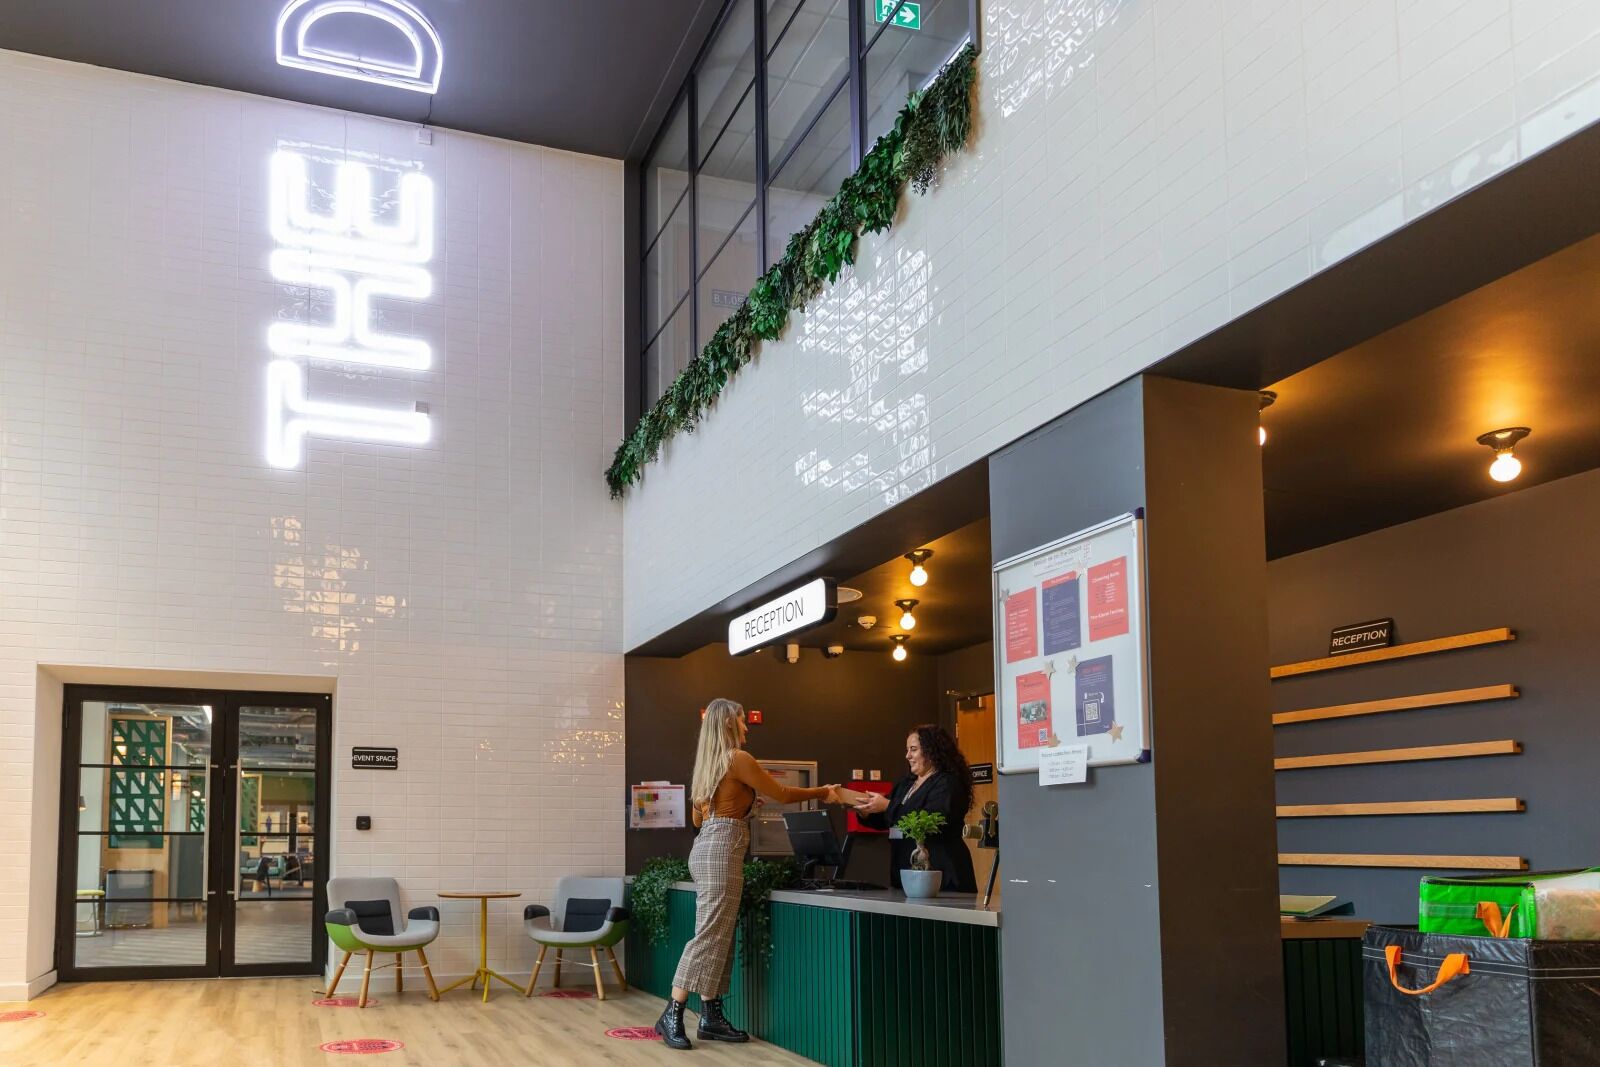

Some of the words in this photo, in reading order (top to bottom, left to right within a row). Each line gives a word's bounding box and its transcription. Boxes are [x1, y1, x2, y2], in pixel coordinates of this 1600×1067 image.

[266, 149, 435, 469] THE
[744, 597, 804, 640] RECEPTION
[1332, 628, 1387, 647] RECEPTION
[353, 754, 375, 762] EVENT
[375, 755, 396, 763] SPACE
[972, 769, 988, 778] OFFICE
